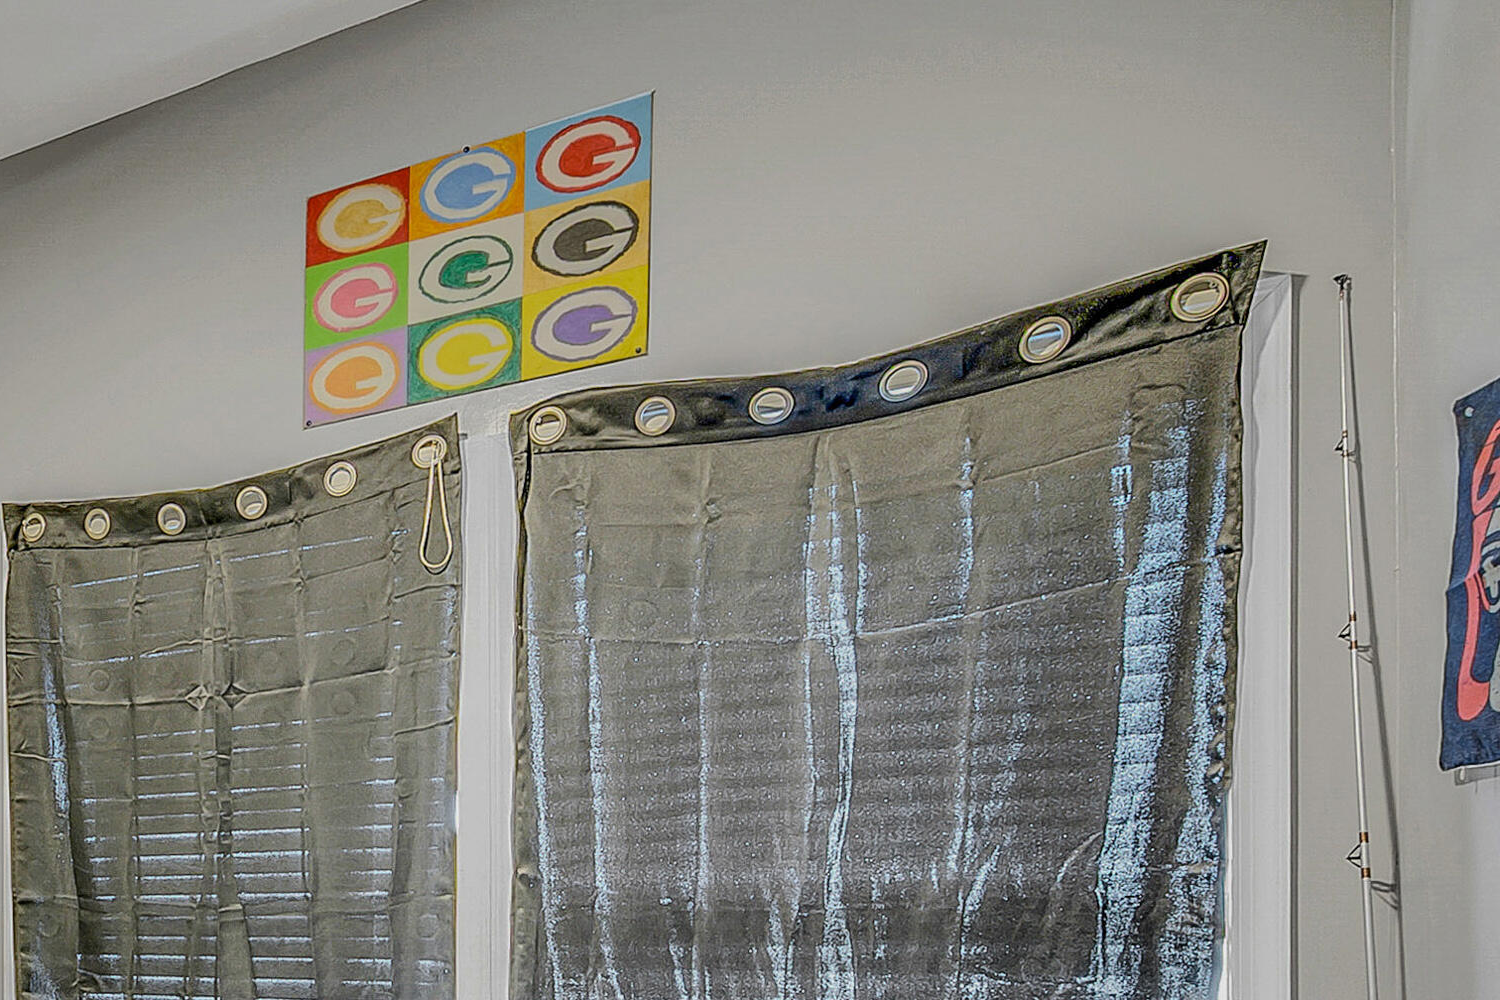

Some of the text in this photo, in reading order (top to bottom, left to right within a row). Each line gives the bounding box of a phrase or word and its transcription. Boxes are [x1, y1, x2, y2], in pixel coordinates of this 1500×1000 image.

[317, 115, 641, 253] G G G
[313, 201, 639, 332] G G G
[309, 286, 637, 414] G G G
